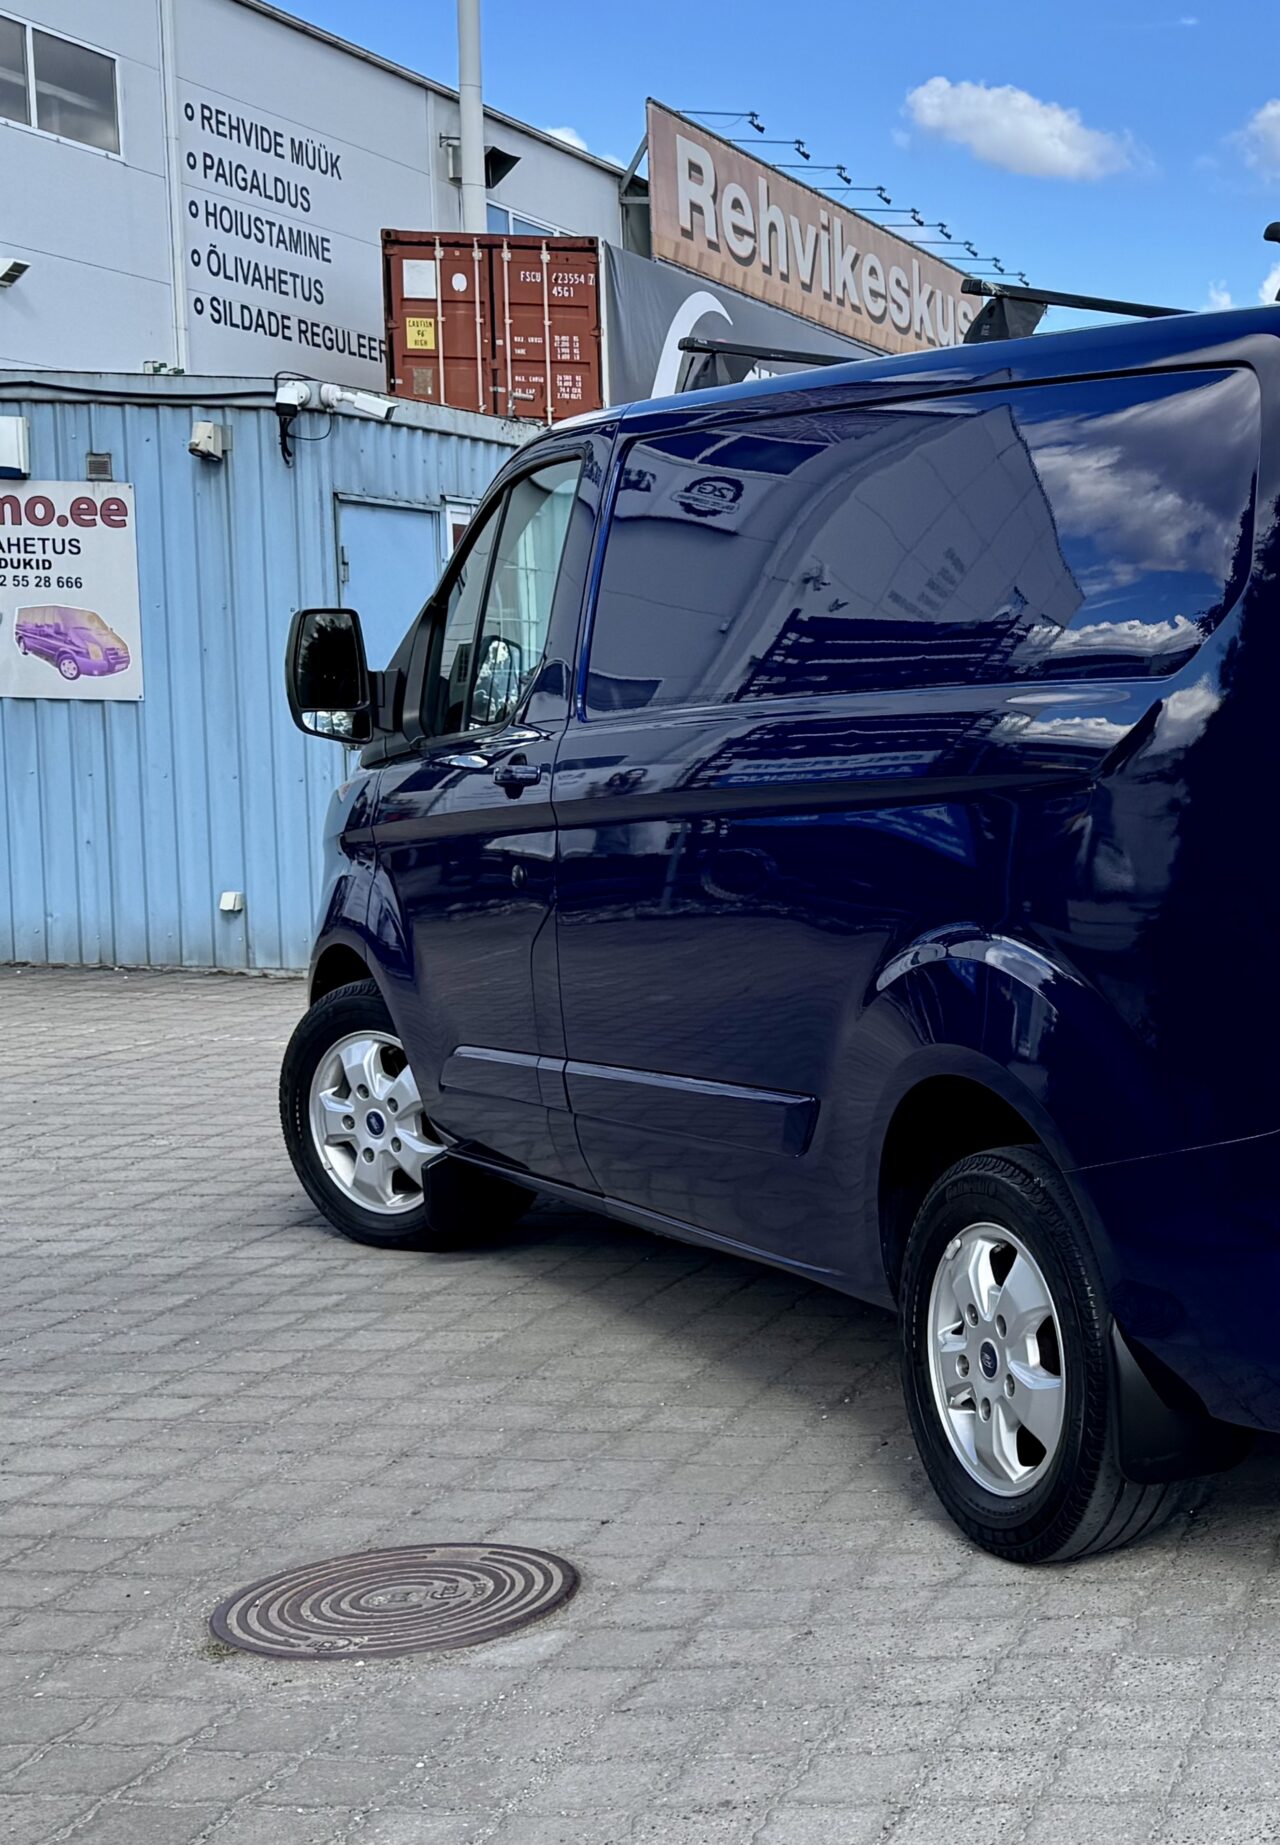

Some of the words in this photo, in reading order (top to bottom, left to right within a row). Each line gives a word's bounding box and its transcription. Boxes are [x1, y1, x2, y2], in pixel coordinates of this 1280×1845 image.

[200, 103, 285, 159] REHVIDE
[290, 137, 342, 180] MÜÜK
[202, 152, 311, 213] PAIGALDUS
[205, 199, 332, 264] HOIUSTAMINE
[676, 134, 975, 346] Rehvikeskus
[206, 243, 325, 305] ÕLIVAHETUS
[209, 296, 293, 341] SILDADE
[12, 575, 30, 588] 55
[34, 575, 52, 588] 28
[56, 576, 83, 589] 666
